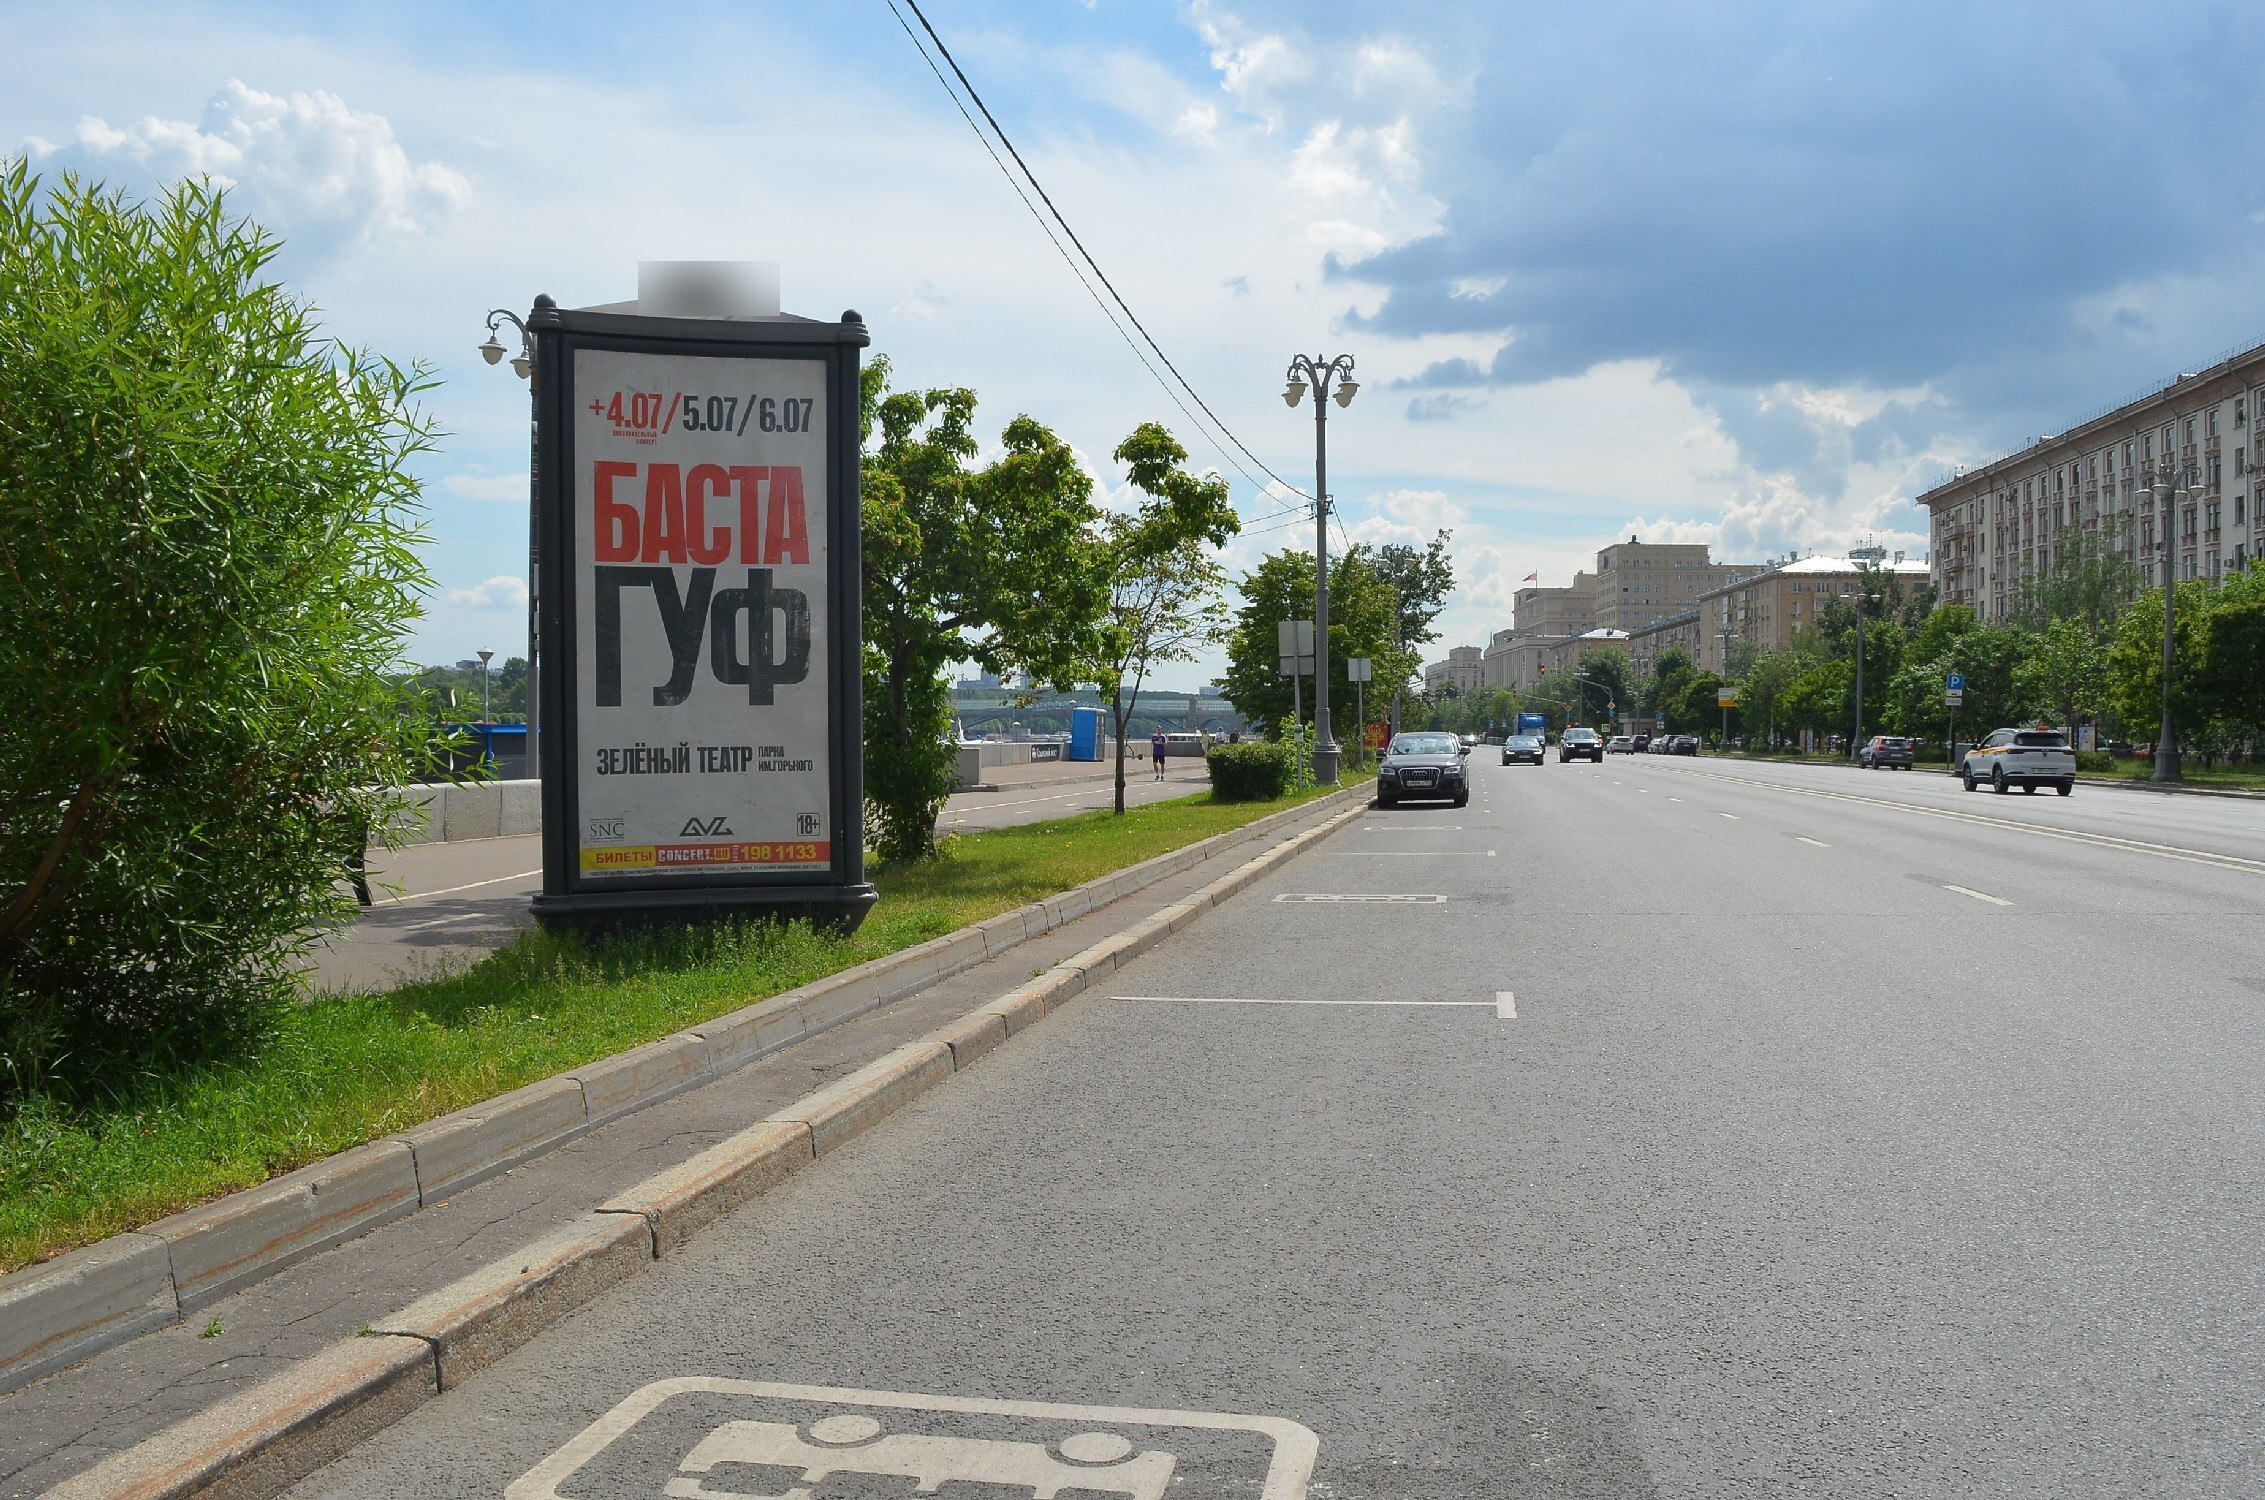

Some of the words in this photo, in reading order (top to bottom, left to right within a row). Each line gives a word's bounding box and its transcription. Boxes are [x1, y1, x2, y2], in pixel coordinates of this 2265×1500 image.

[594, 460, 810, 565] БАСТА
[594, 565, 811, 707] ГУФ
[596, 742, 691, 775] ЗЕЛЁНЫЙ
[697, 746, 753, 773] ТЕАТР
[590, 822, 625, 838] SNC
[798, 814, 819, 835] 18+
[595, 851, 653, 865] БИЛЕТЫ
[740, 845, 772, 861] 198
[775, 844, 817, 860] 1133
